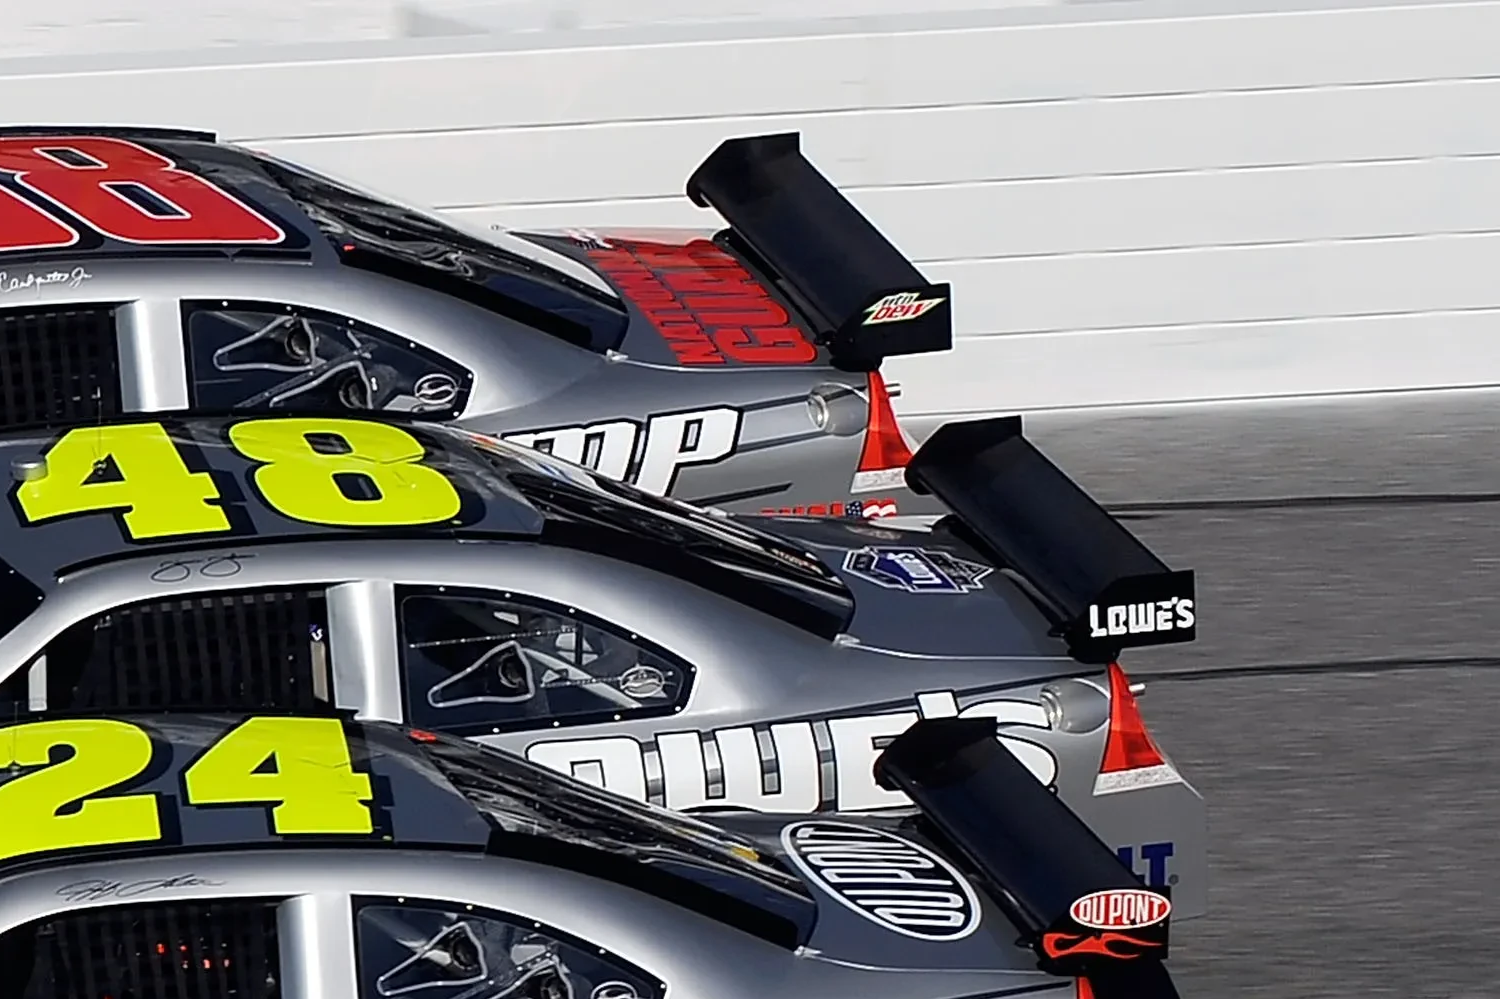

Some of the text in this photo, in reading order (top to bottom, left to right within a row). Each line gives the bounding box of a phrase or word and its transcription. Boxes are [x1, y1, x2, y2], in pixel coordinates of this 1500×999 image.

[14, 418, 463, 541] 48
[500, 405, 742, 497] MP
[1089, 596, 1195, 638] LOWE'S
[525, 689, 1059, 813] OWE'S
